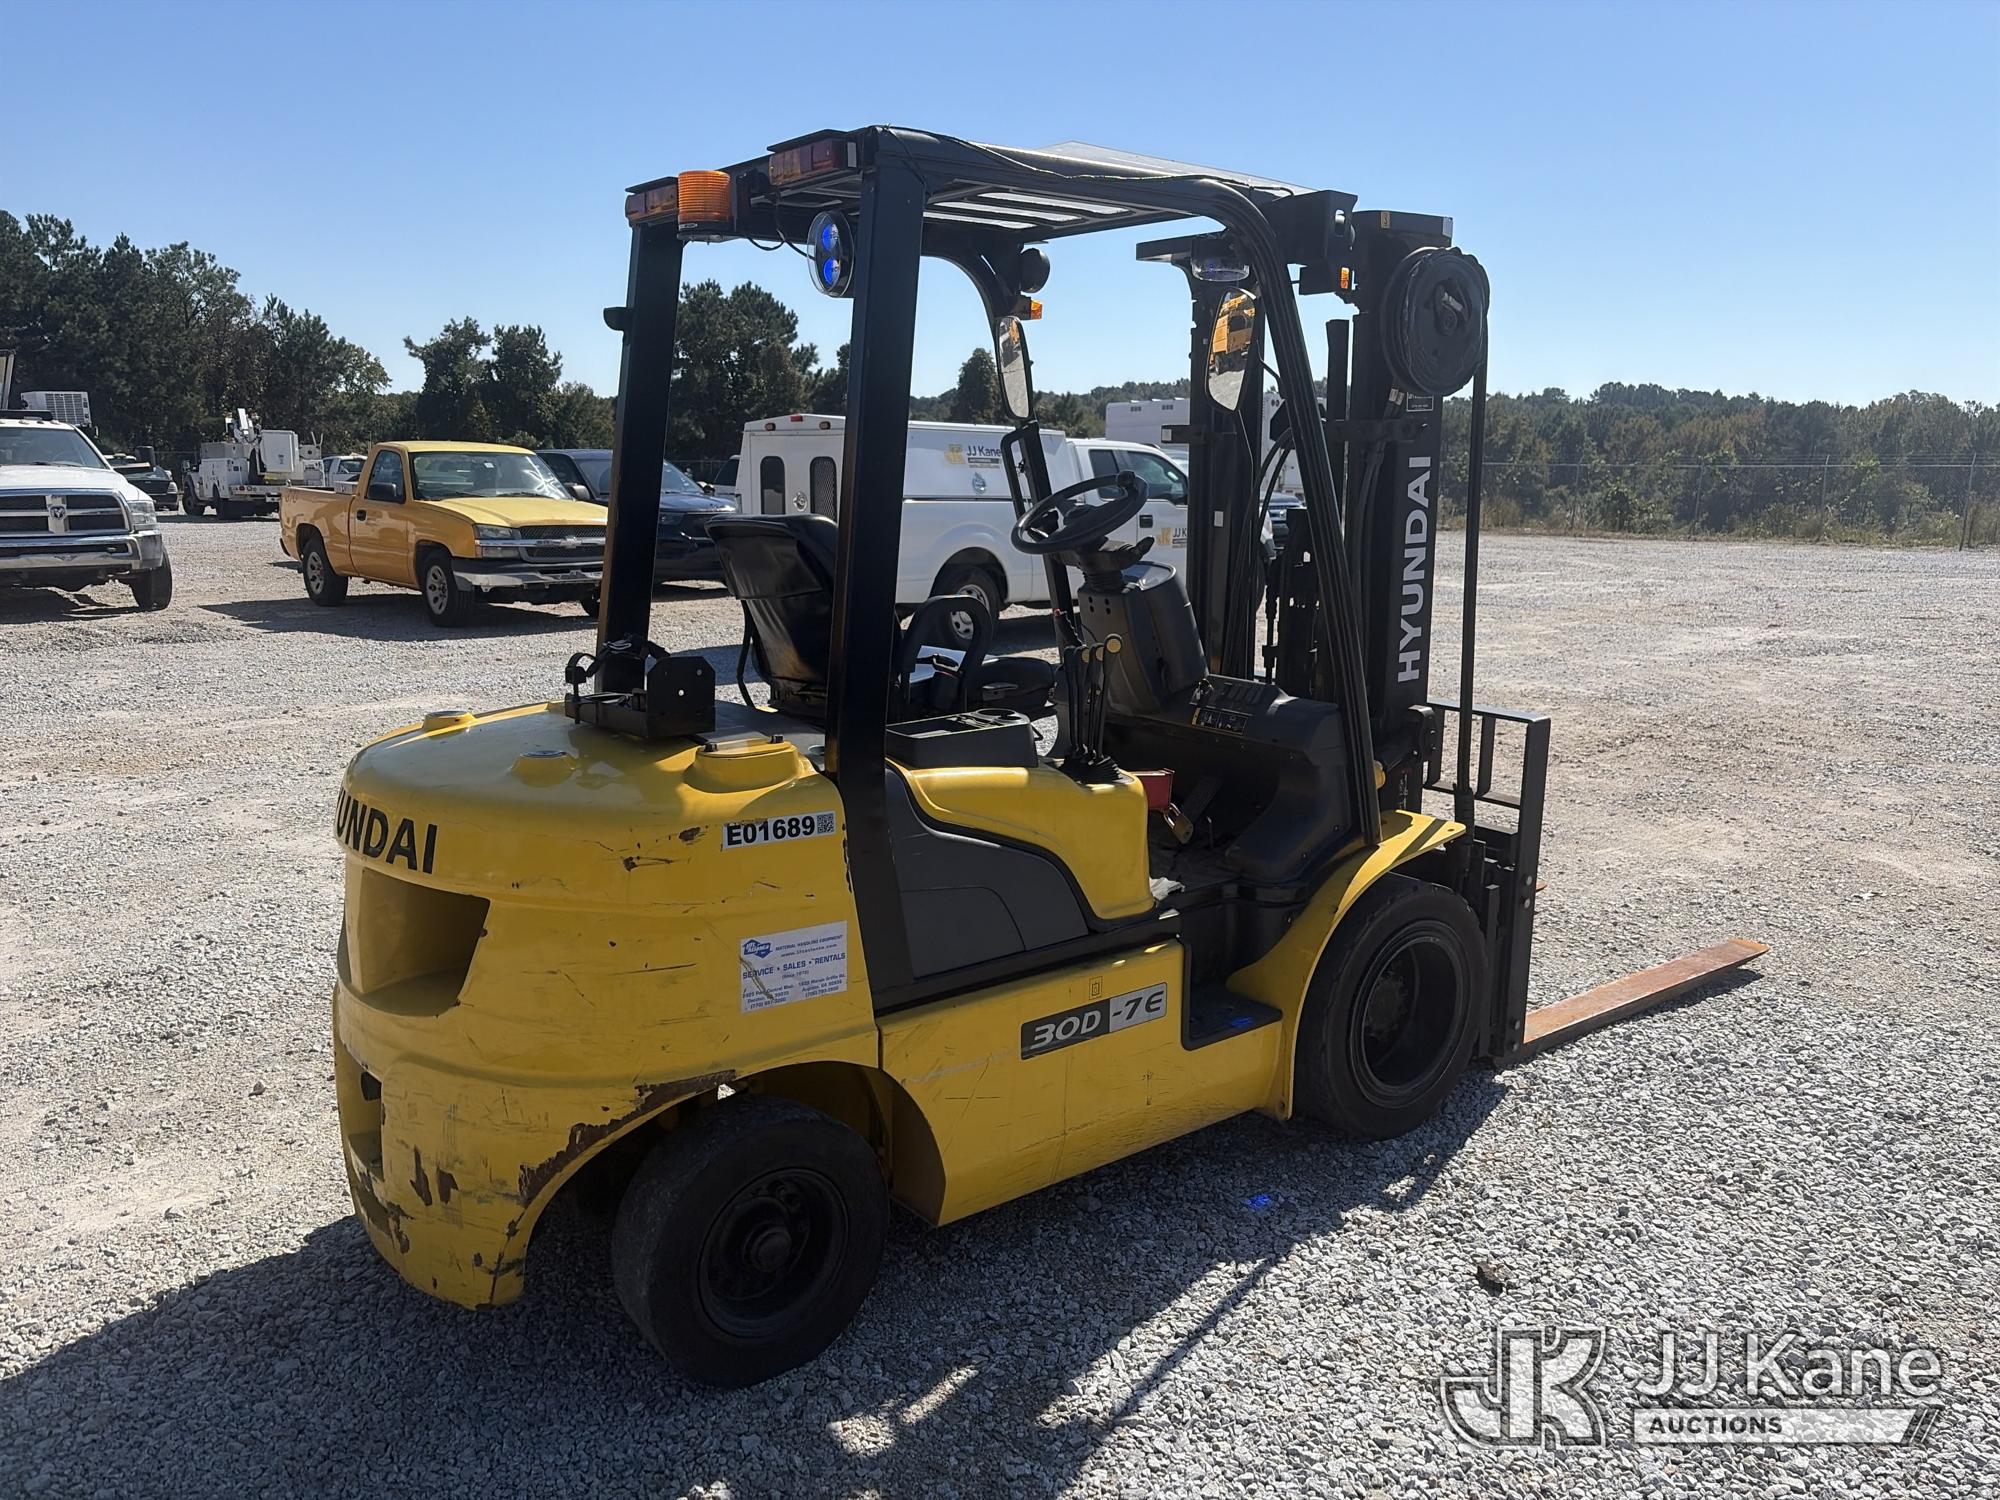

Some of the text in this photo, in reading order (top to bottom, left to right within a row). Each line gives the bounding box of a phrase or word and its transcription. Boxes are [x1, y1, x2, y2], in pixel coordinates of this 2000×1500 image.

[967, 445, 1001, 457] JJ Kane
[1397, 456, 1431, 683] HYUNDAI
[337, 787, 438, 875] UNDAI
[726, 815, 816, 846] E01689
[742, 952, 846, 980] SERVICE SALES RENTALS
